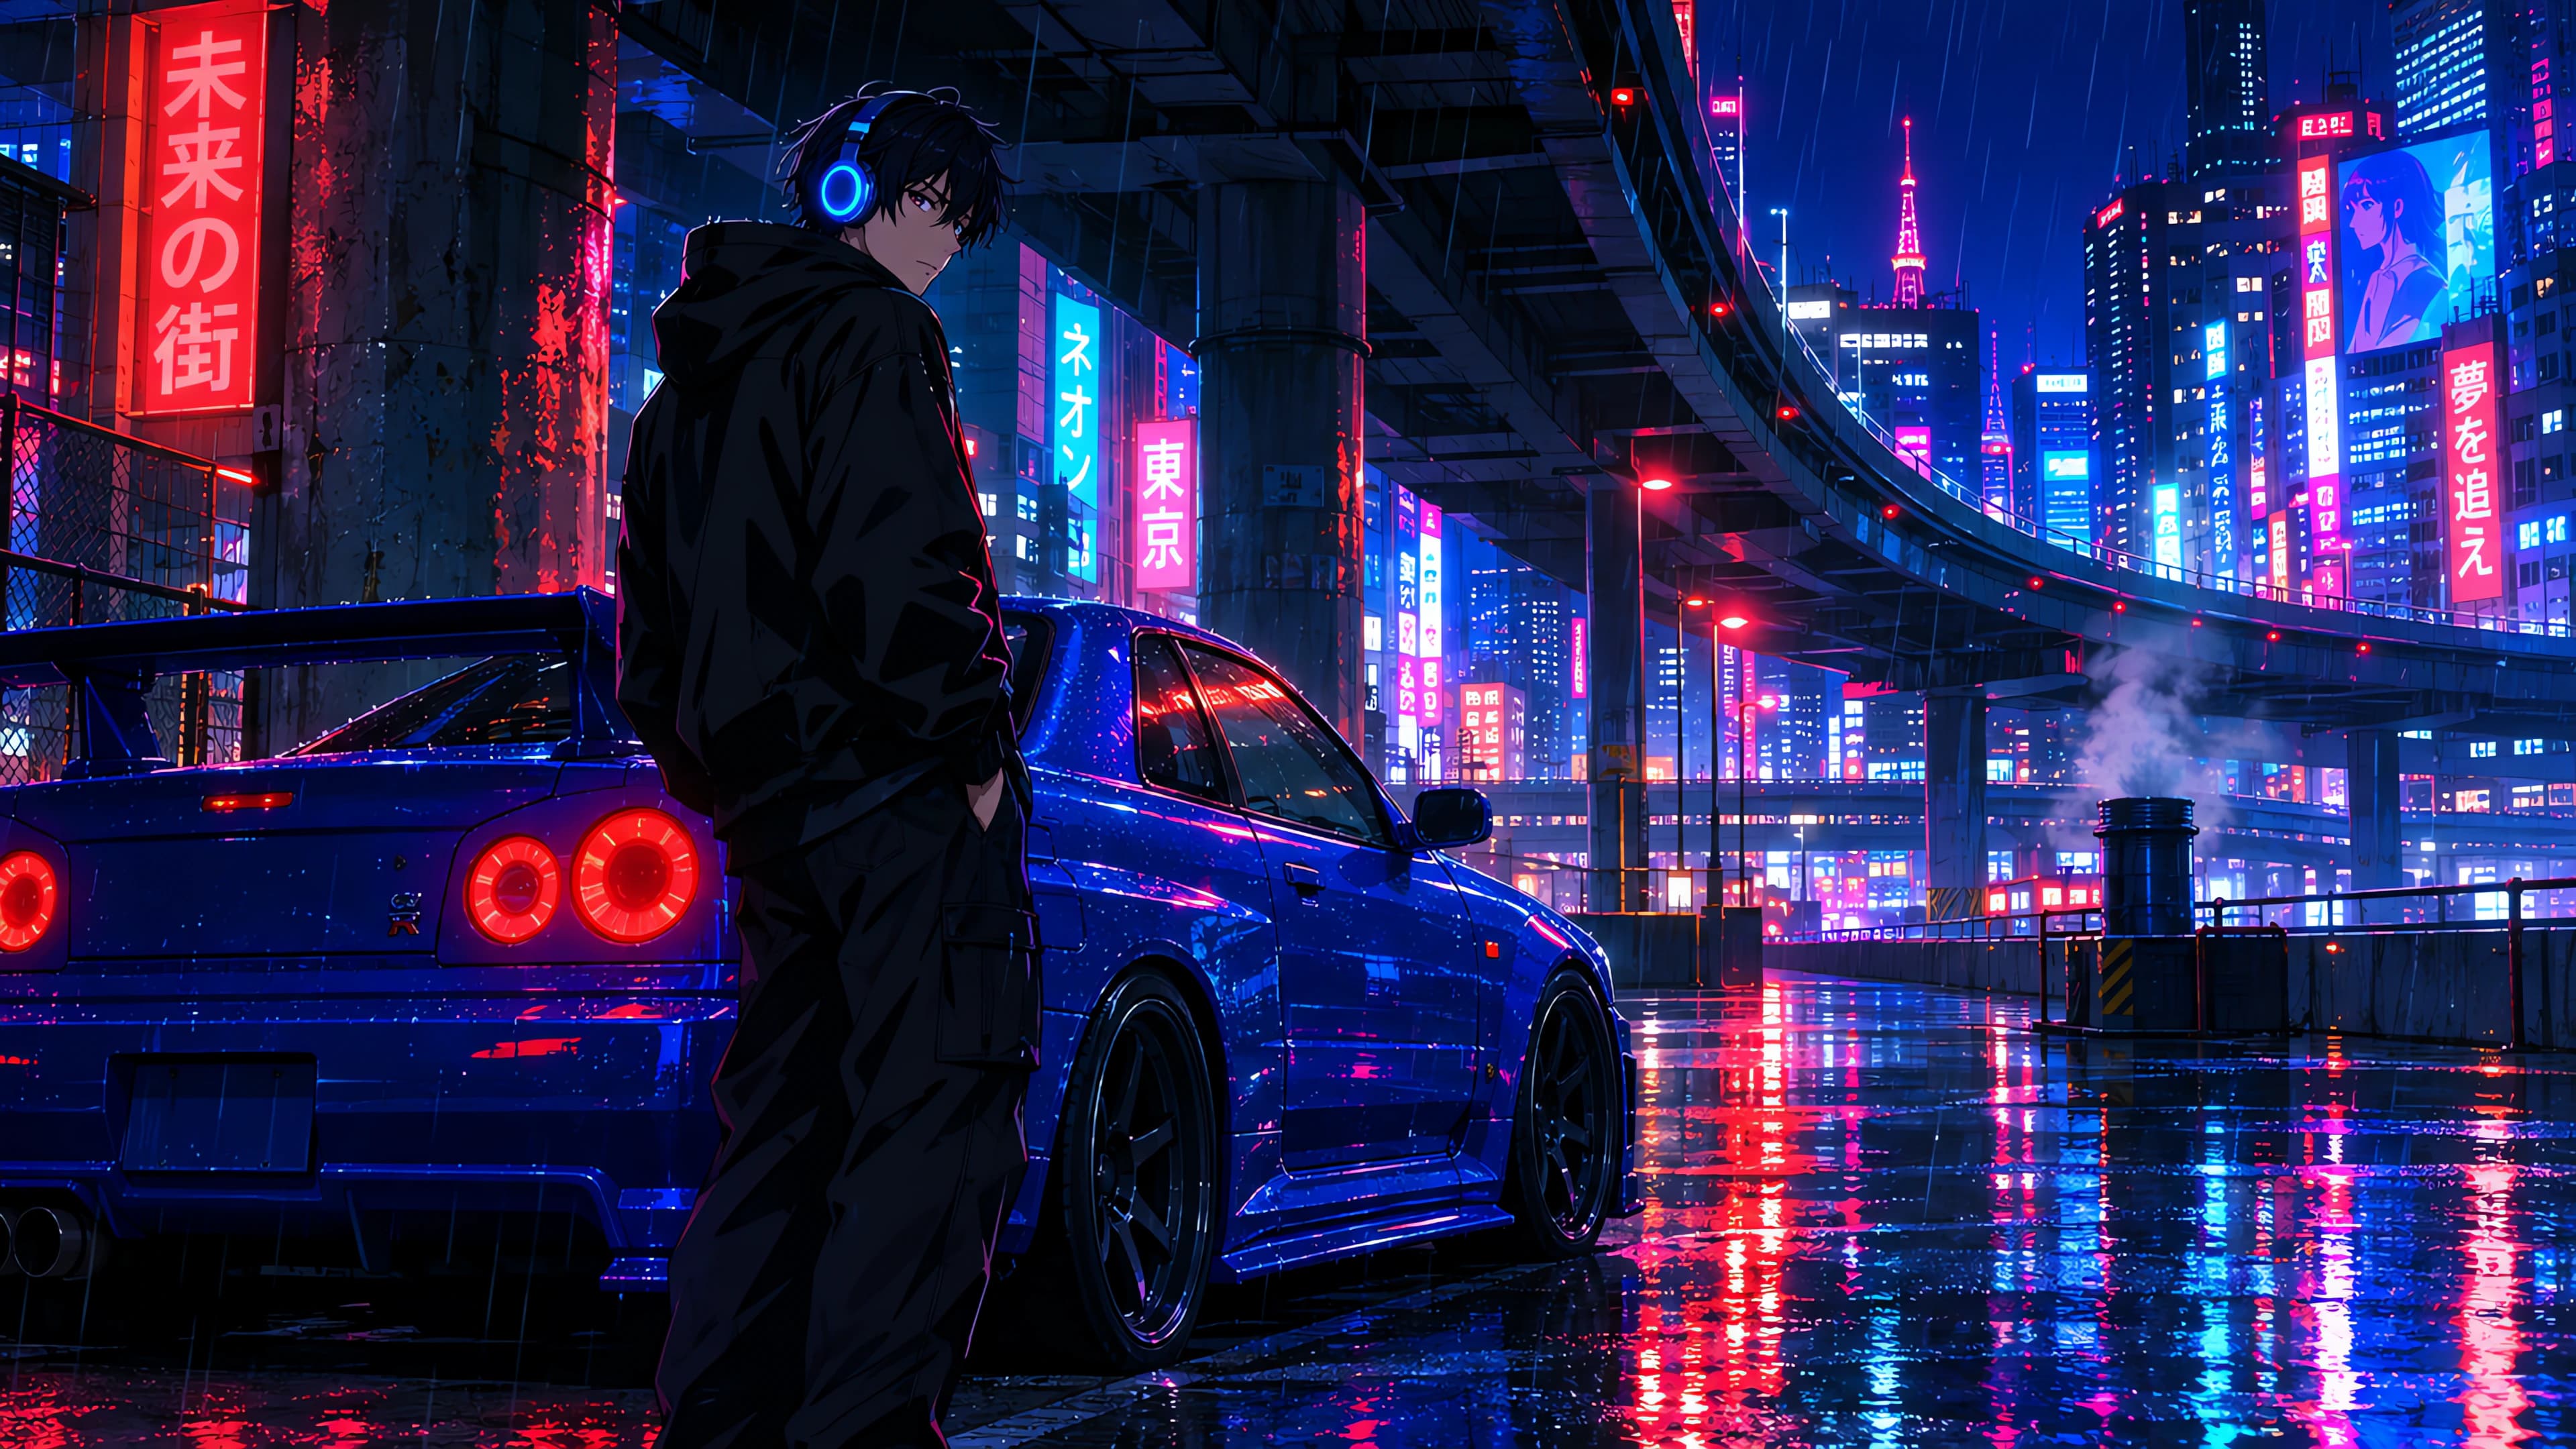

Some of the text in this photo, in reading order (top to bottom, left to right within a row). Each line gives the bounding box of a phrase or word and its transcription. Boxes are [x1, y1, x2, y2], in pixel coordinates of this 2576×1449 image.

[154, 31, 247, 395] 未来の街
[1060, 323, 1092, 491] ネオン
[2450, 360, 2494, 578] 夢を追え
[1142, 438, 1185, 570] 東京
